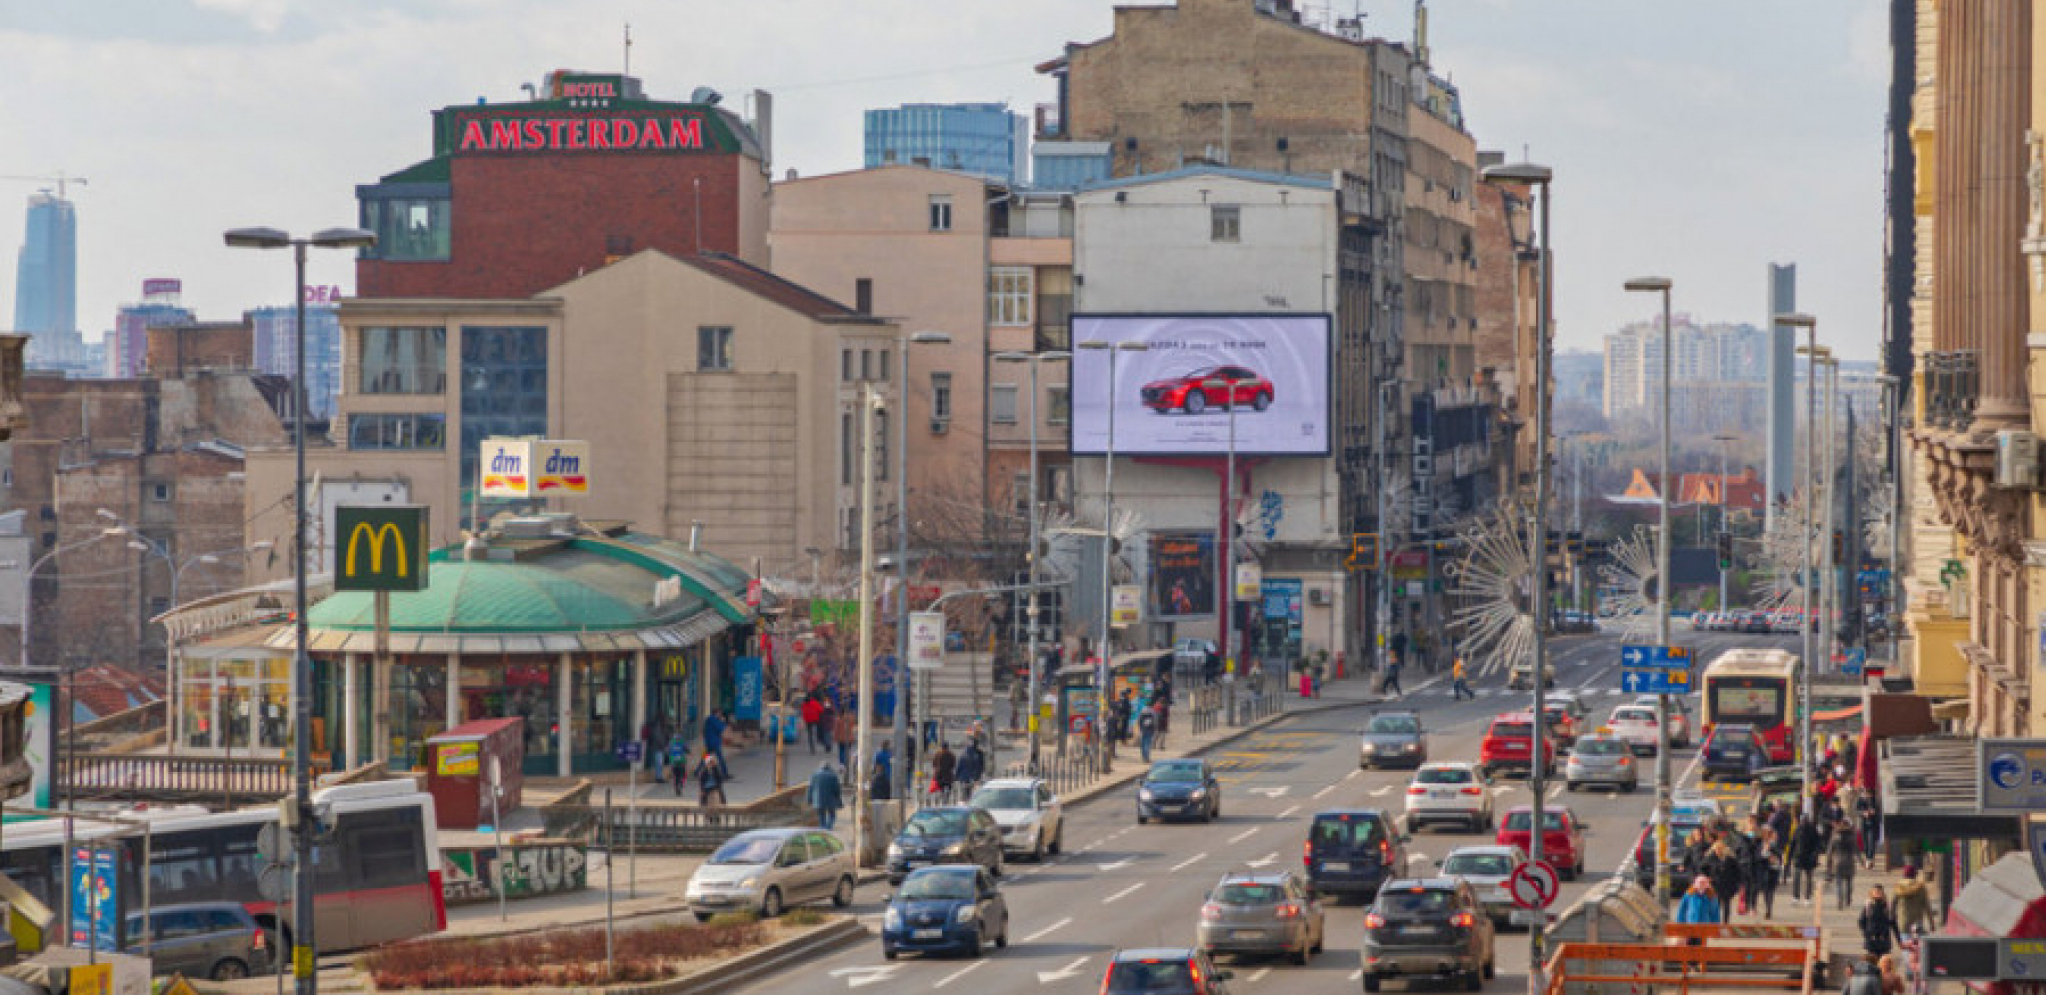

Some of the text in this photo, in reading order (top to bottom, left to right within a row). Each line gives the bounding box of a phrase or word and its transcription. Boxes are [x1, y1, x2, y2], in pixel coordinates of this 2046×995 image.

[563, 81, 617, 97] HOTEL
[459, 118, 703, 150] AMSTERDAM
[491, 446, 521, 474] dm
[545, 448, 579, 474] dm
[1412, 434, 1433, 534] HOTEL
